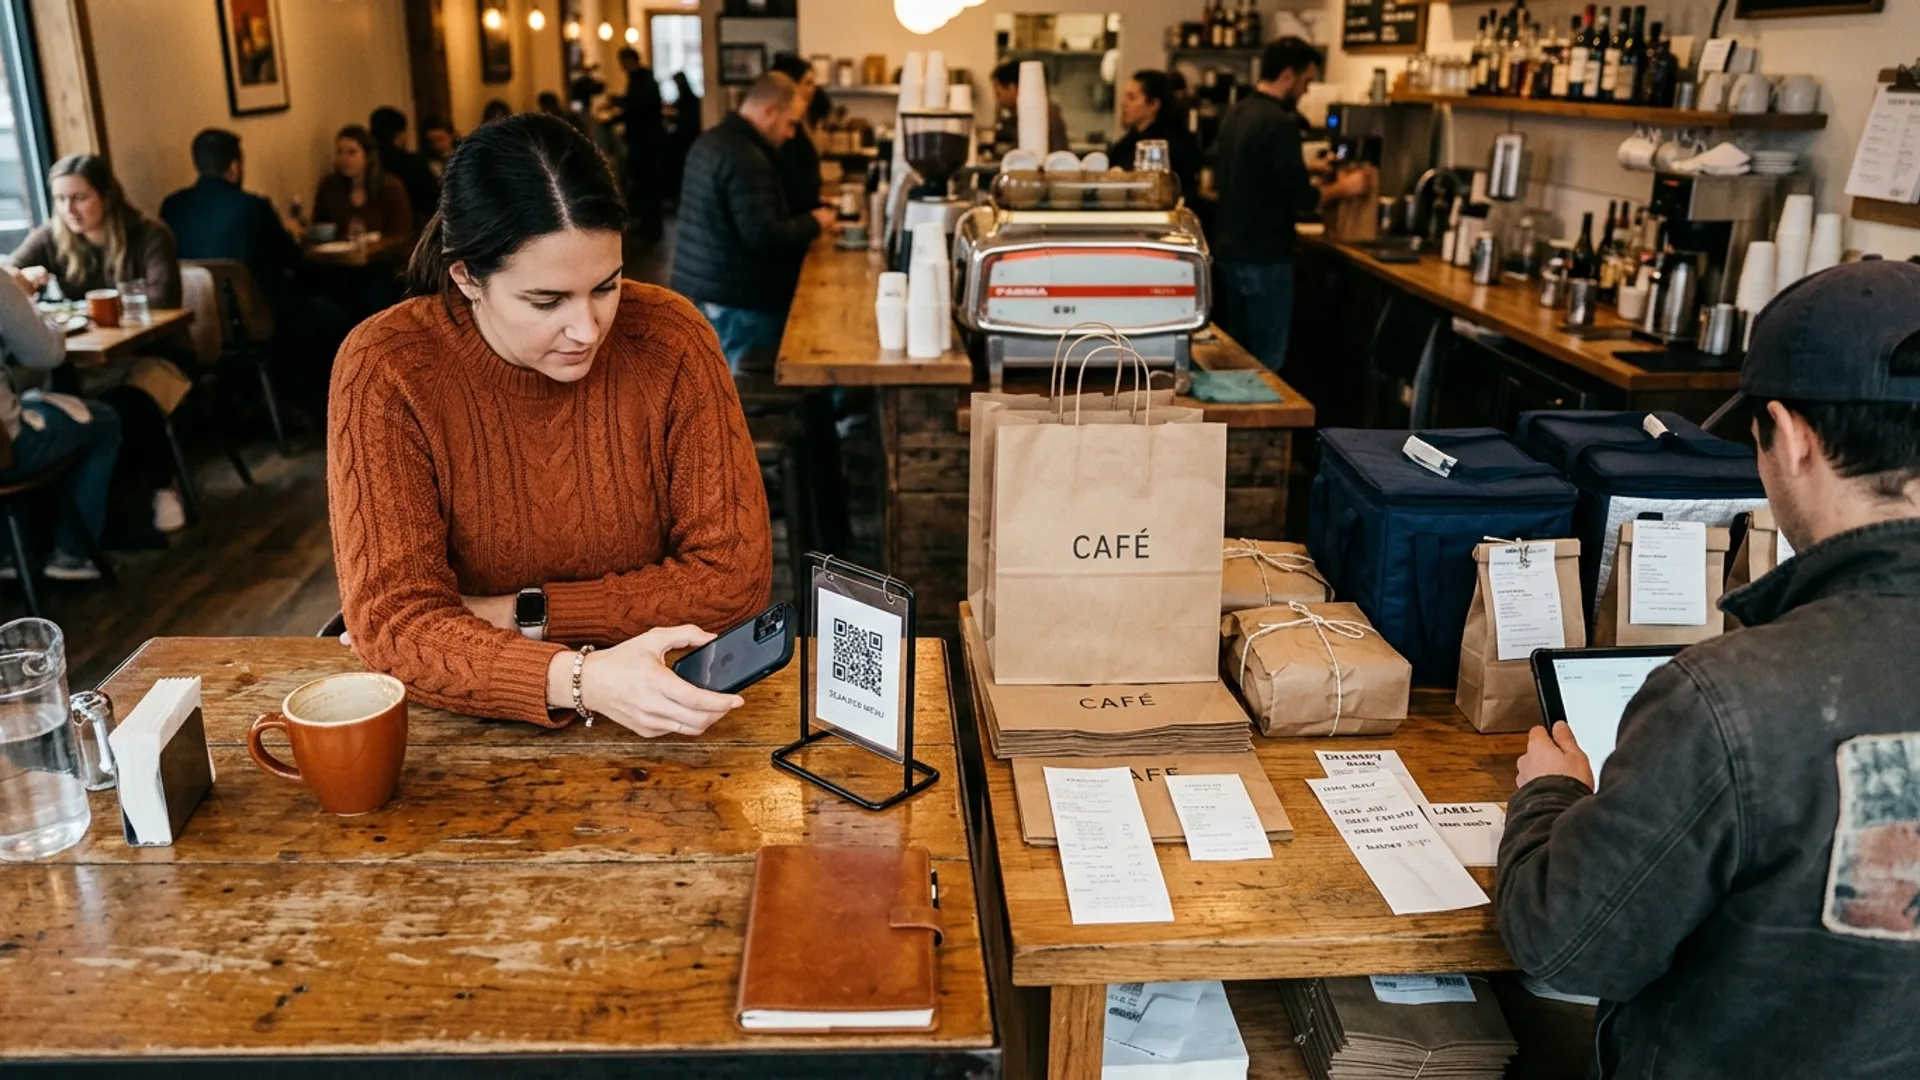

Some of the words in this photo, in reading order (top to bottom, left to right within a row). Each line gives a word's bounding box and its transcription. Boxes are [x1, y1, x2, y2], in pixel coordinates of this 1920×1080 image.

[1073, 528, 1149, 559] CAFÉ
[1079, 692, 1156, 709] CAFÉ
[1130, 763, 1178, 781] AFÉ
